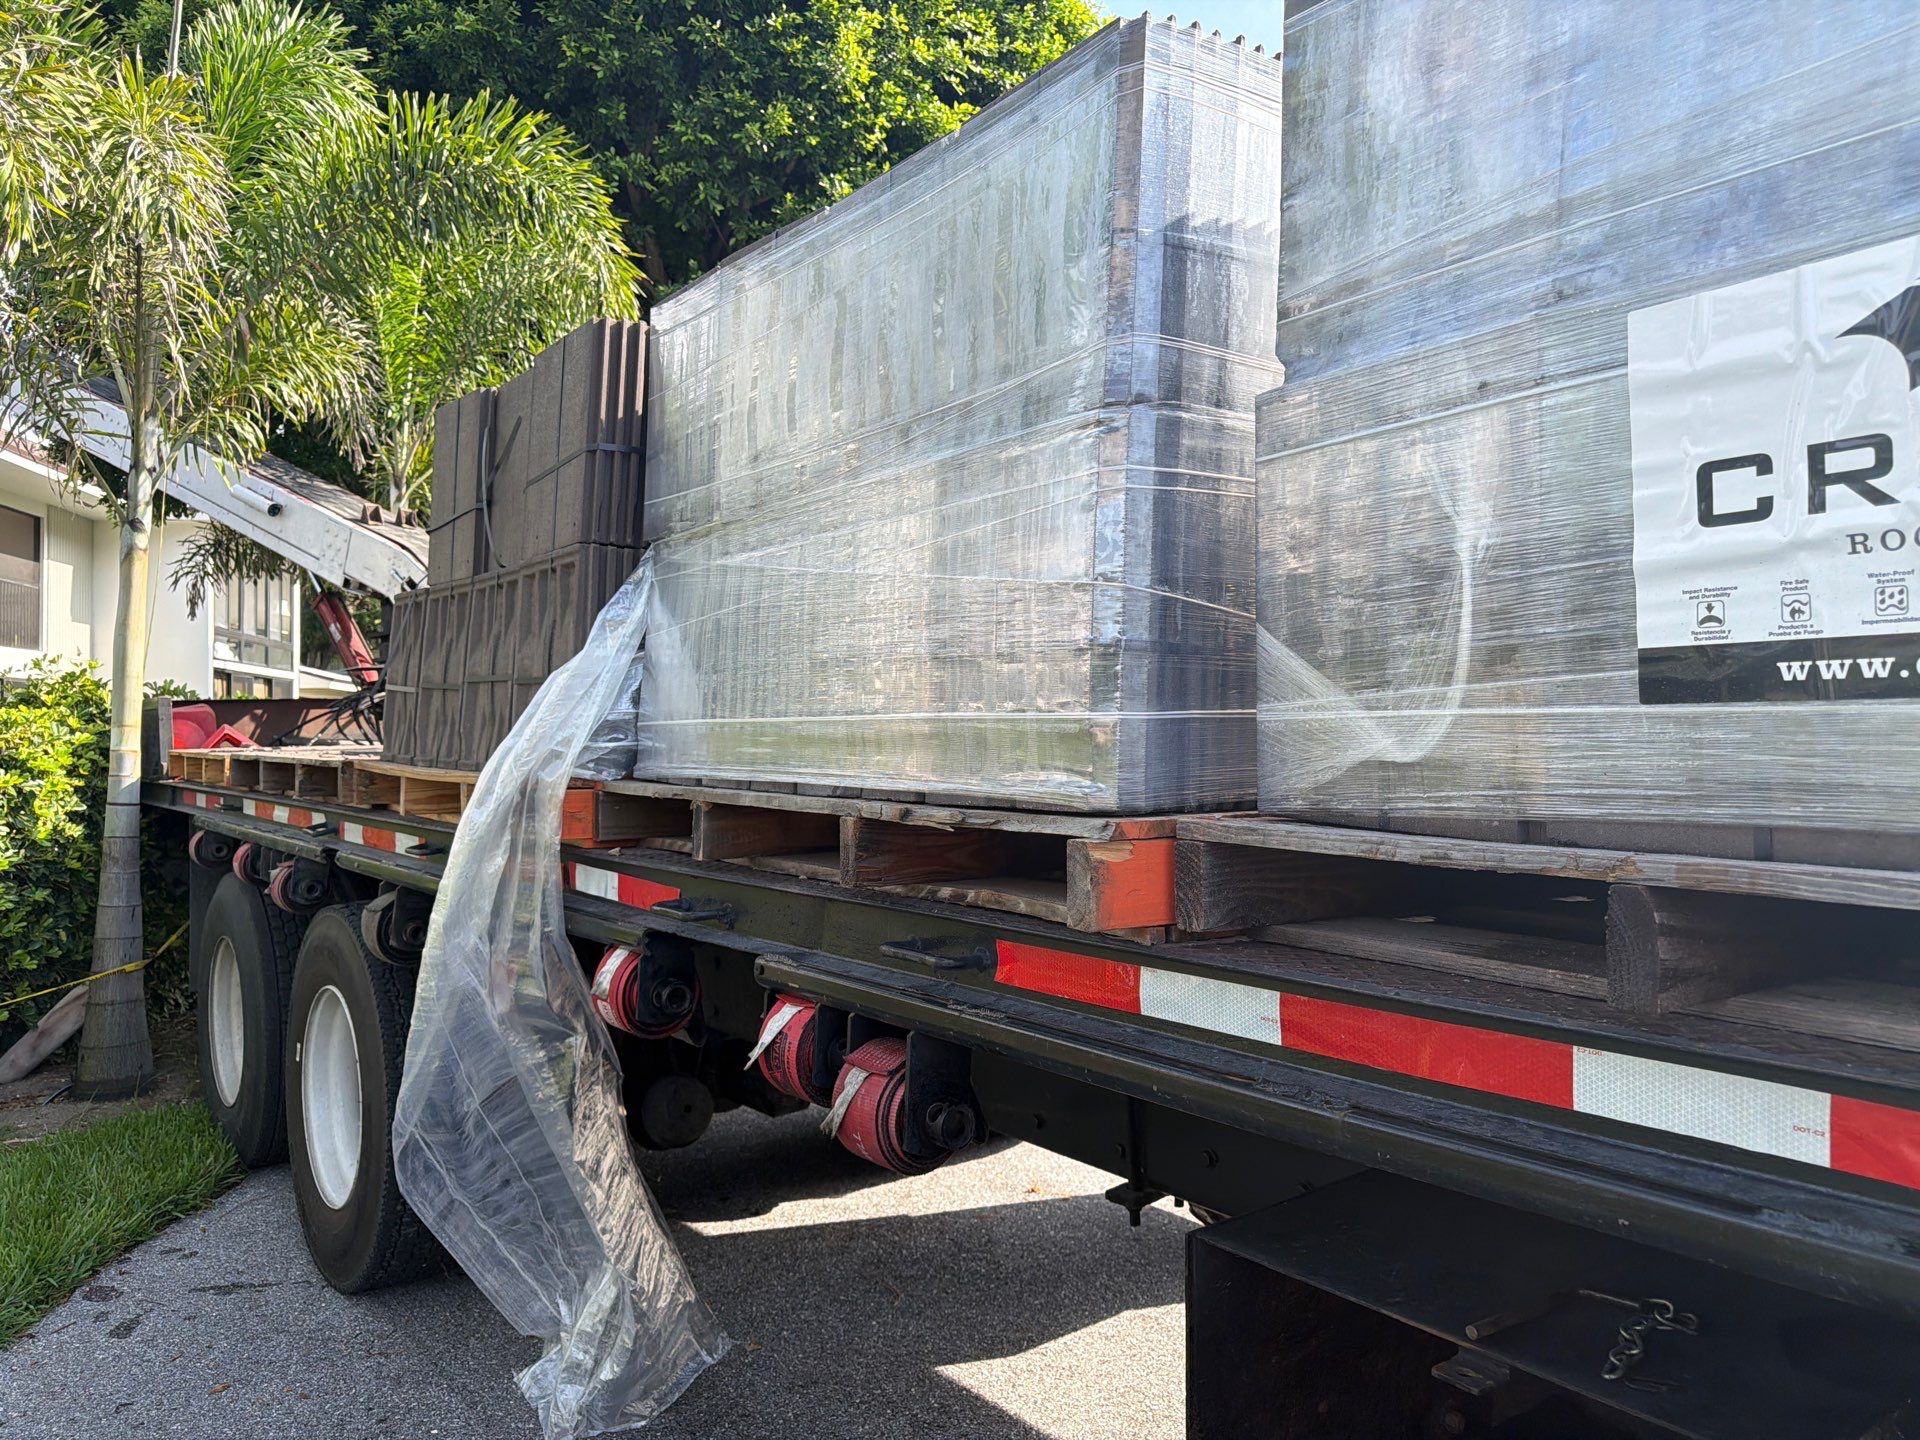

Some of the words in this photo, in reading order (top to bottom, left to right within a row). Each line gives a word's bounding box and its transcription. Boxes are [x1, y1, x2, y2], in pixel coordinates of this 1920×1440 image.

[1846, 527, 1920, 556] RO
[1867, 569, 1915, 578] Water-Proof
[1776, 657, 1920, 681] www.
[1793, 1125, 1826, 1137] DOT-C2
